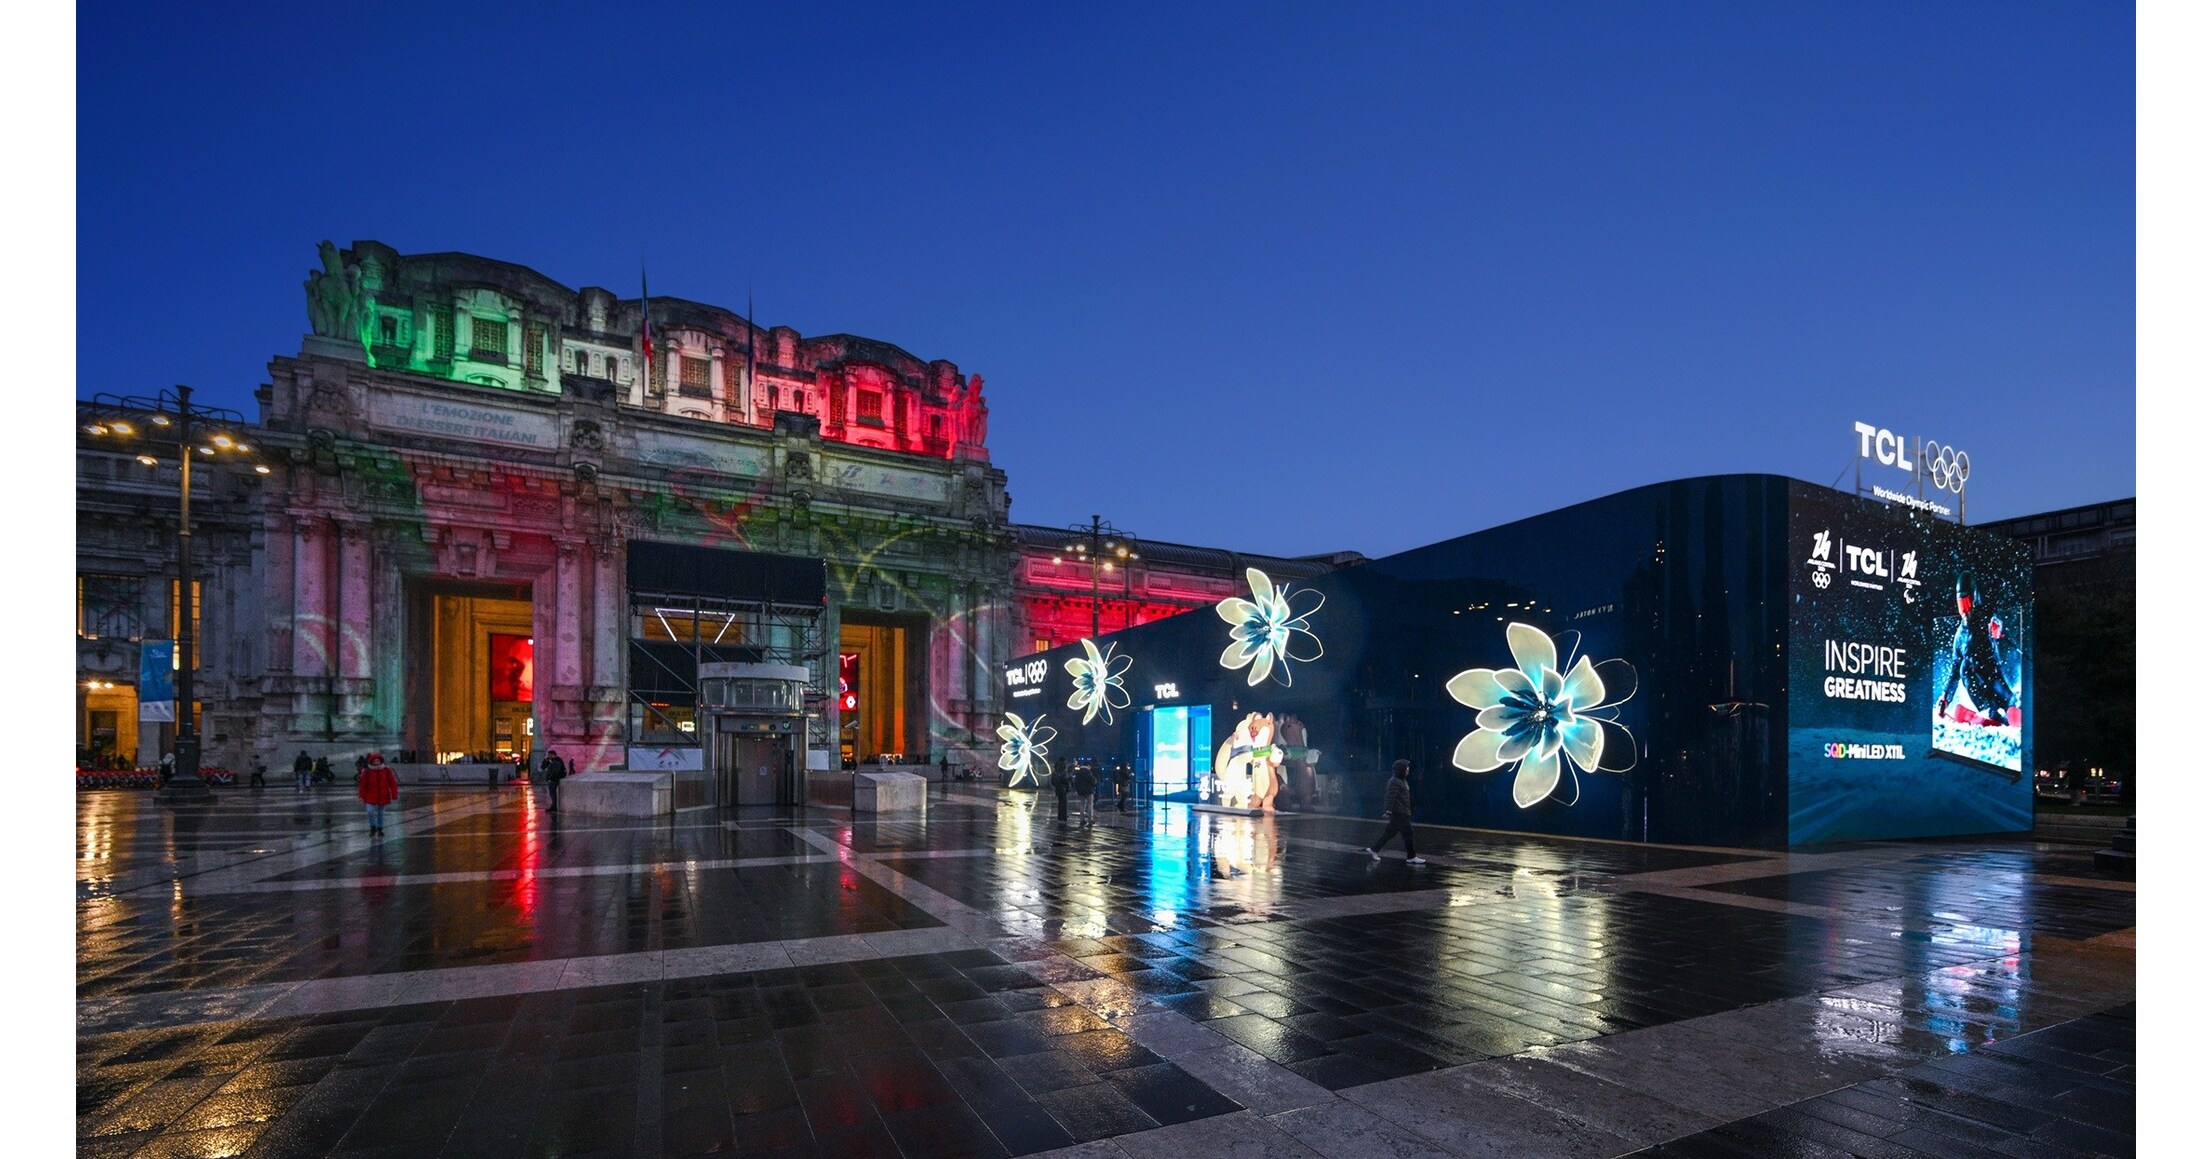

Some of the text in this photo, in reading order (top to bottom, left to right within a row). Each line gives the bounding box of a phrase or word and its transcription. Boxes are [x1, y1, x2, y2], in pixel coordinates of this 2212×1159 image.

[416, 417, 473, 435] ESSERE
[421, 403, 515, 426] L'EMOZIONE
[1855, 421, 1913, 472] TCL
[1873, 485, 1950, 515] Worldwide Olympic Partner
[1845, 545, 1888, 577] TCL
[1825, 639, 1906, 678] INSPIRE
[1006, 668, 1025, 686] TCL
[1824, 676, 1906, 703] GREATNESS
[1155, 683, 1179, 699] TCL
